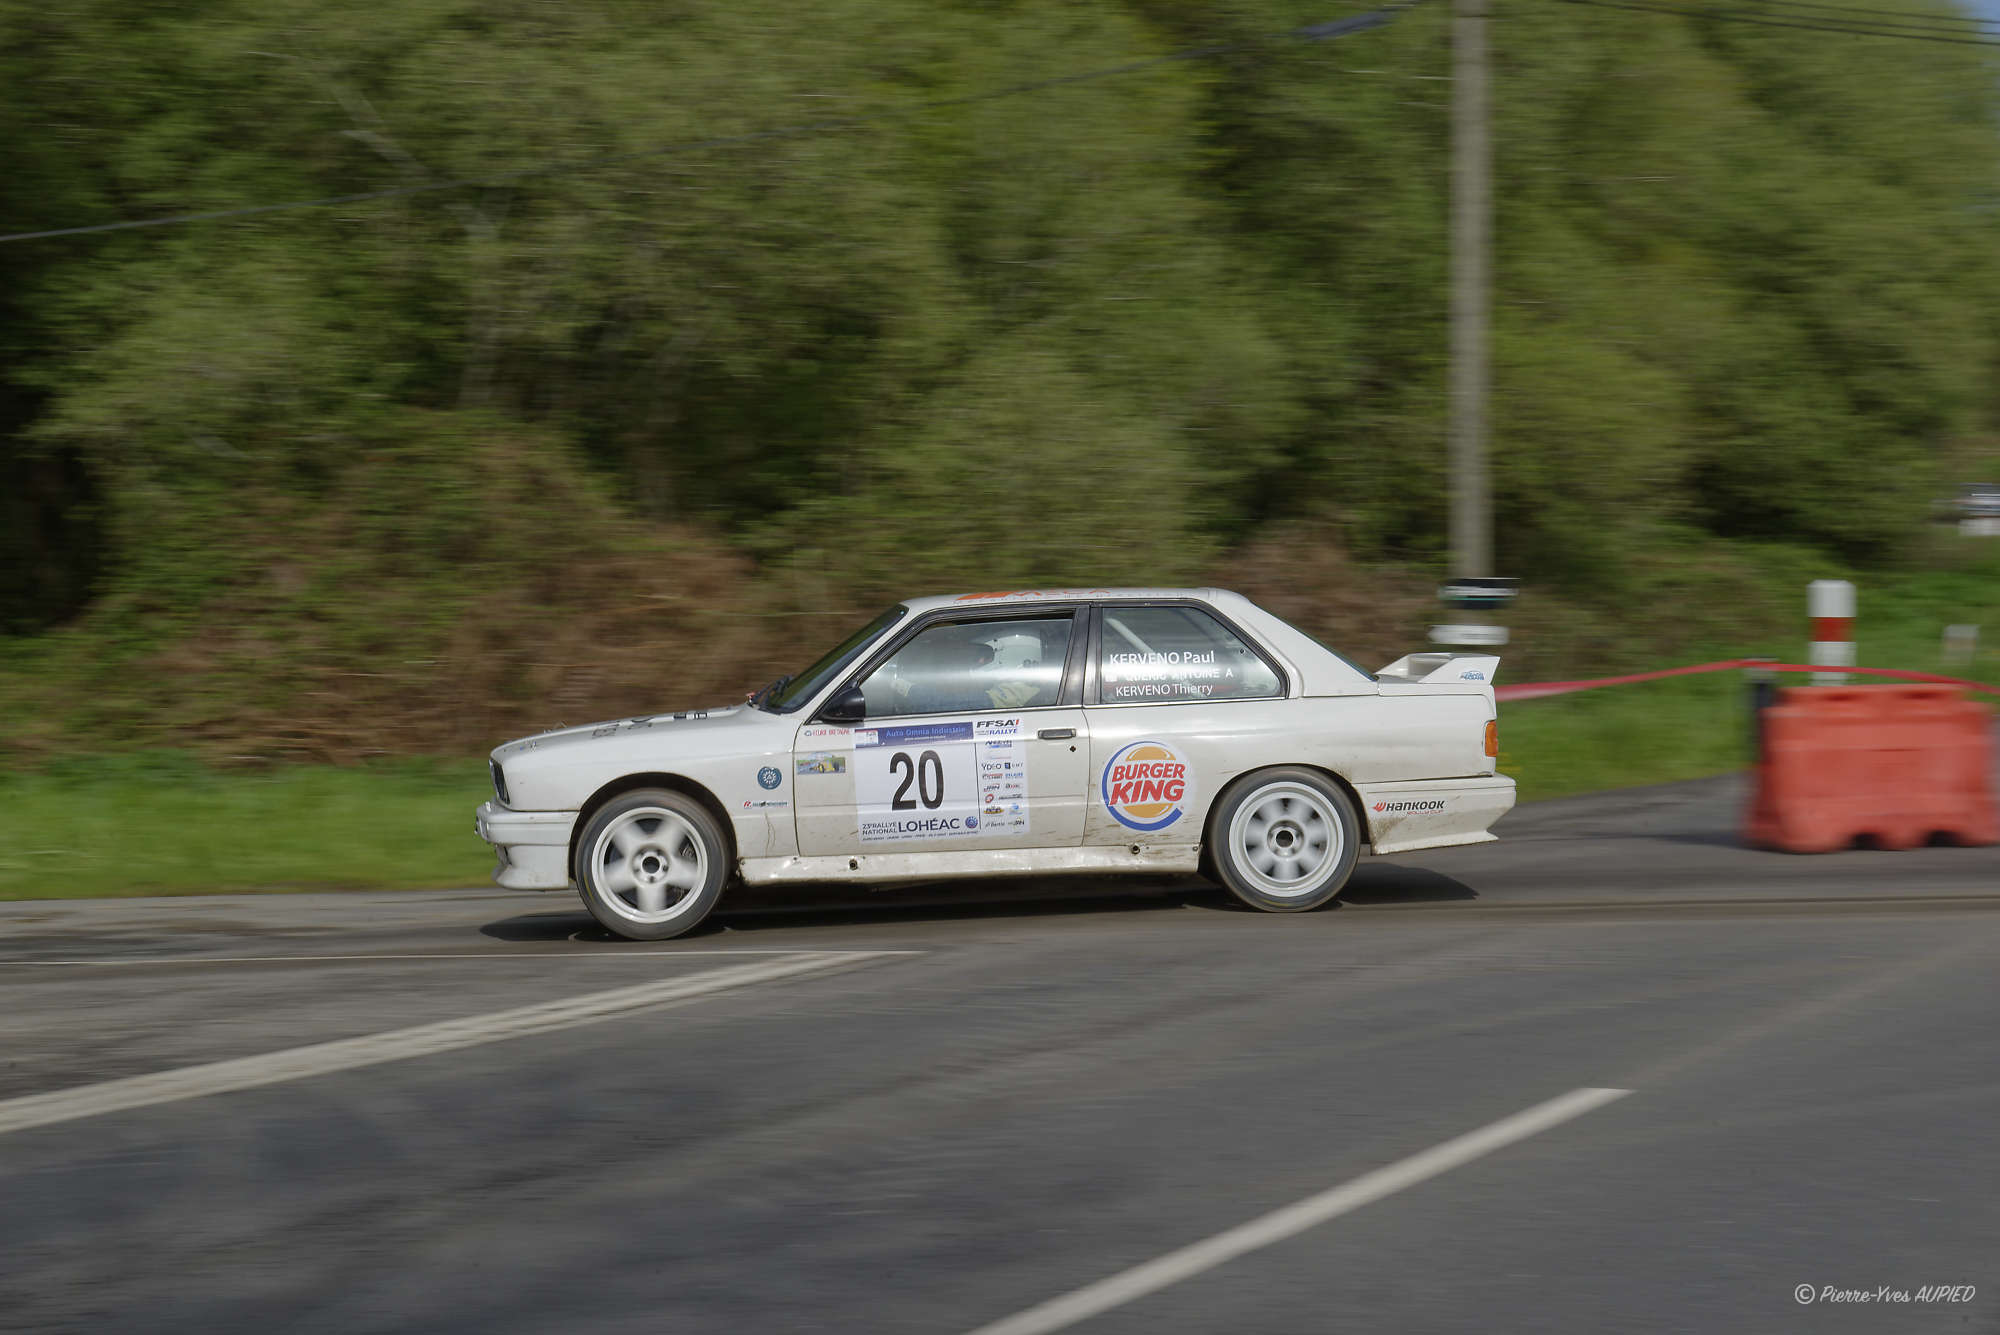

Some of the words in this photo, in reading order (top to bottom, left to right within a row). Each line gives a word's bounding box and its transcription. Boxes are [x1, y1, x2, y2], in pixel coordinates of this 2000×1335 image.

[1110, 652, 1180, 665] KERVENO
[1183, 650, 1215, 664] Paul
[1225, 667, 1234, 678] A
[1115, 684, 1171, 697] KERVENO
[1172, 683, 1213, 696] Thierry
[976, 719, 1015, 728] FFSA
[886, 728, 904, 737] Auto
[906, 727, 930, 736] Omnia
[1111, 762, 1186, 782] BURGER
[890, 749, 944, 811] 20
[1109, 779, 1186, 806] KING
[862, 828, 898, 836] NATIONAL
[898, 818, 961, 833] LOHÉAC
